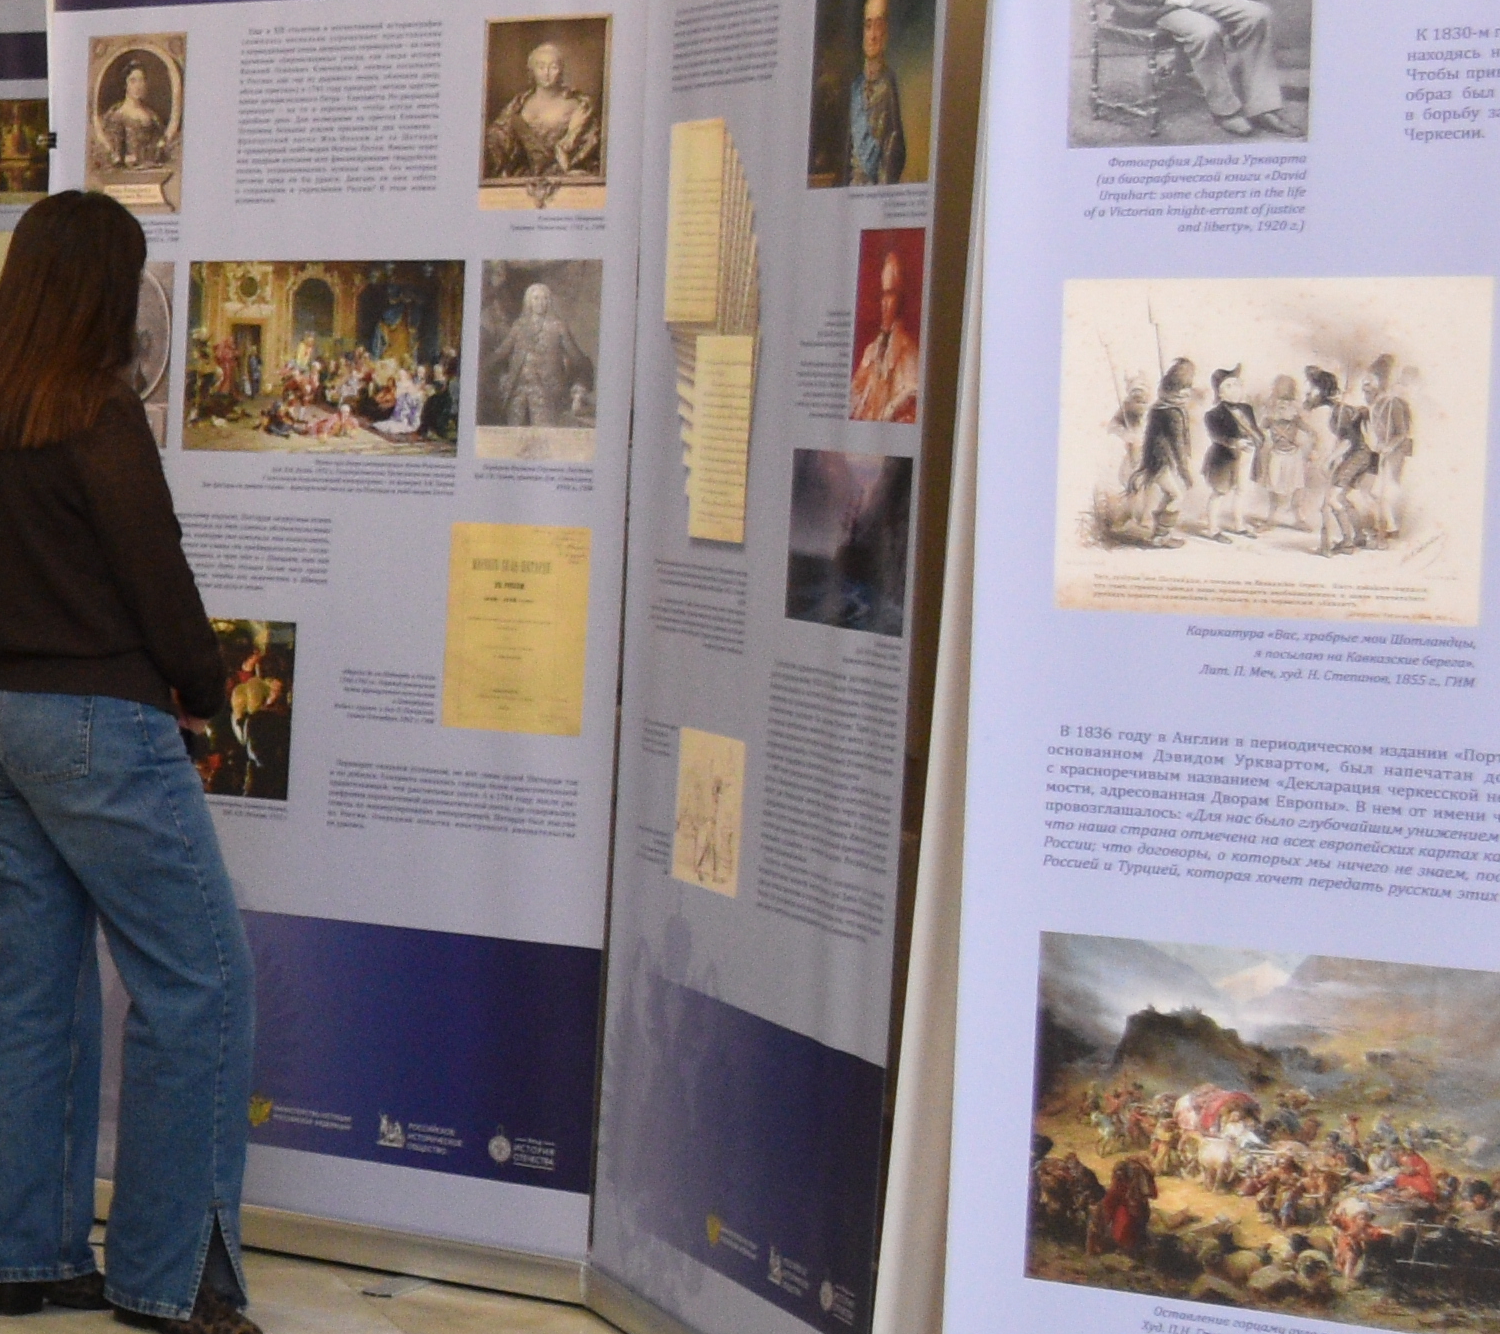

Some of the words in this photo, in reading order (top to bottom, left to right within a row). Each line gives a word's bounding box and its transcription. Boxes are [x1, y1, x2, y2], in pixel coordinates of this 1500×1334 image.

[1416, 27, 1428, 42] К
[1434, 25, 1490, 42] 1830-м
[1404, 126, 1486, 145] Черкесии.
[1107, 155, 1191, 171] Фотография
[1191, 153, 1240, 168] Дэвида
[1241, 153, 1308, 168] Уркварта
[1159, 190, 1192, 201] some
[1193, 187, 1248, 202] chapters
[1249, 189, 1262, 200] in
[1263, 185, 1285, 199] the
[1286, 185, 1307, 201] life
[1185, 623, 1266, 642] Карикатура
[1266, 627, 1300, 643] «Вас,
[1302, 630, 1360, 646] храбрые
[1359, 634, 1388, 645] мои
[1389, 633, 1477, 651] Шотландцы,
[1060, 723, 1071, 738] В
[1077, 725, 1113, 741] 1836
[1117, 730, 1153, 746] году
[1157, 732, 1167, 743] в
[1171, 730, 1230, 748] Англии
[1235, 737, 1245, 748] в
[1250, 737, 1374, 756] периодическом
[1379, 745, 1448, 761] издании
[1046, 763, 1055, 774] с
[1060, 764, 1181, 782] красноречивым
[1187, 772, 1270, 789] названием
[1276, 774, 1381, 796] «Декларация
[1387, 785, 1480, 803] черкесской
